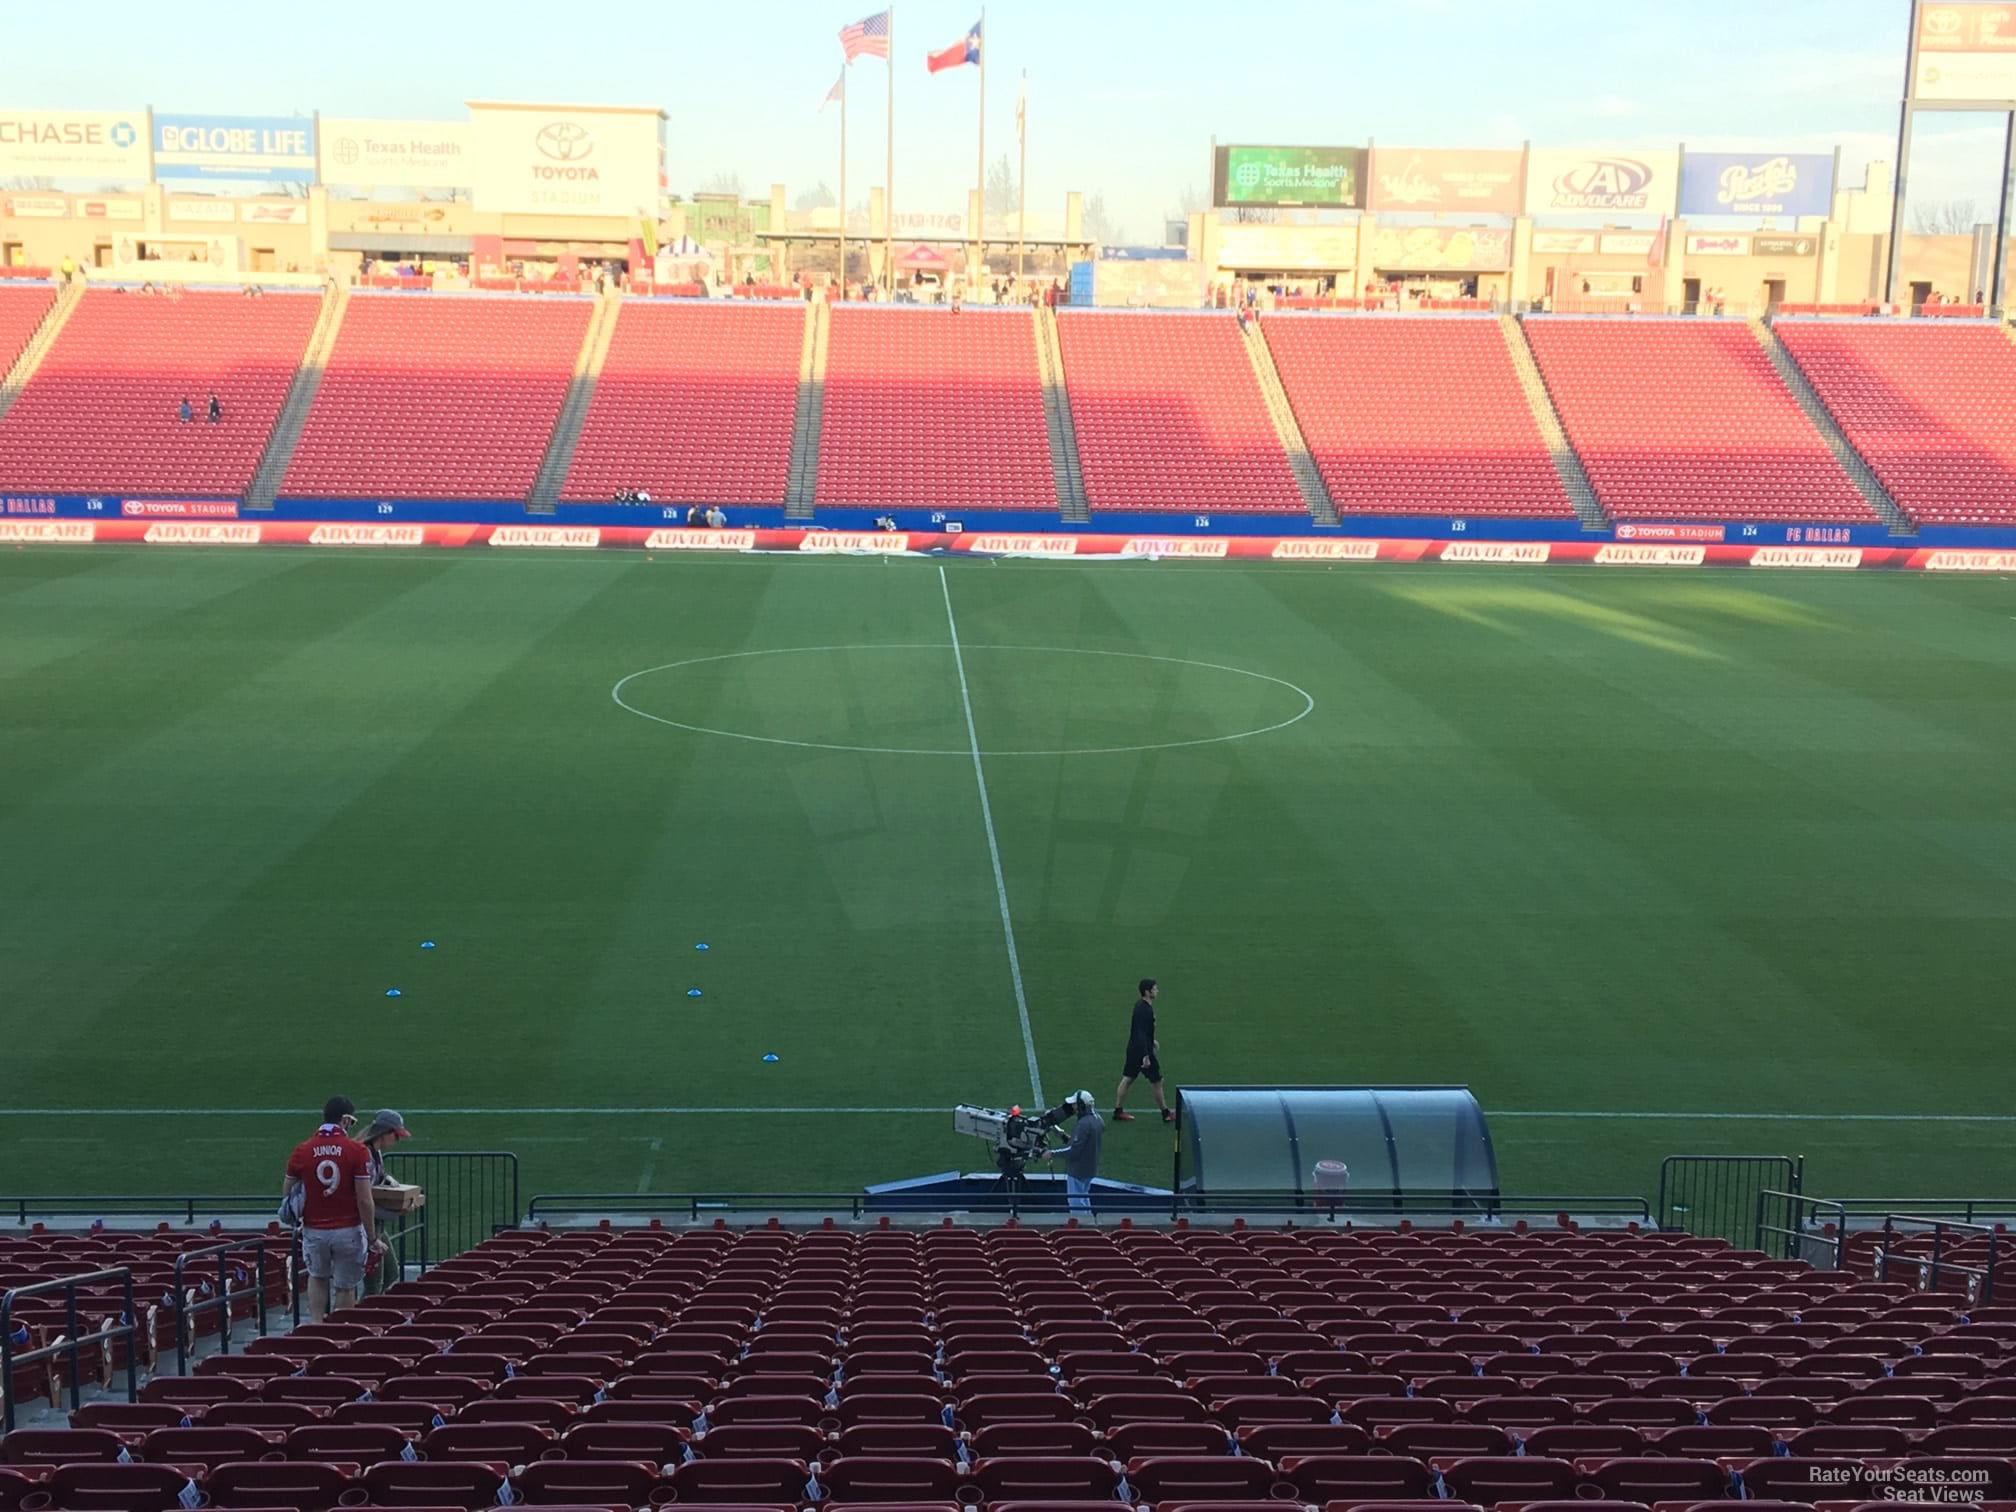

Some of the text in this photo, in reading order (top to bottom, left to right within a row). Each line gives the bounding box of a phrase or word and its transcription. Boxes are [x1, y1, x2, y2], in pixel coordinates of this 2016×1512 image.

[0, 121, 103, 144] CHASE
[180, 128, 306, 154] GLOBE LIFE
[363, 139, 461, 156] Texas Health
[532, 166, 599, 181] TOYOTA
[1264, 164, 1347, 179] Texas Health
[531, 191, 601, 205] STADIUM
[1551, 193, 1648, 209] ADVOCARE
[8, 499, 55, 513] DALLAS
[145, 503, 236, 515] TOYOTA STADIUM
[0, 523, 91, 538] DVOCARE
[151, 525, 258, 540] ADVOCARE
[315, 527, 420, 542] ADVOCARE
[495, 529, 598, 544] ADVOCARE
[1638, 527, 1722, 538] TOYOTA STADIUM
[1786, 528, 1850, 542] FC DALLAS
[650, 532, 754, 547] ADVOCARE
[805, 534, 905, 549] ADVOCARE
[978, 537, 1077, 552] ADVOCARE
[1126, 540, 1228, 555] ADVOCARE
[1276, 543, 1376, 557] ADVOCARE
[1447, 545, 1549, 560] ADVOCARE
[1603, 547, 1701, 562] ADVOCARE
[1757, 550, 1860, 564] ADVOCARE
[313, 1145, 342, 1157] JUNIOR
[316, 1160, 341, 1197] 9
